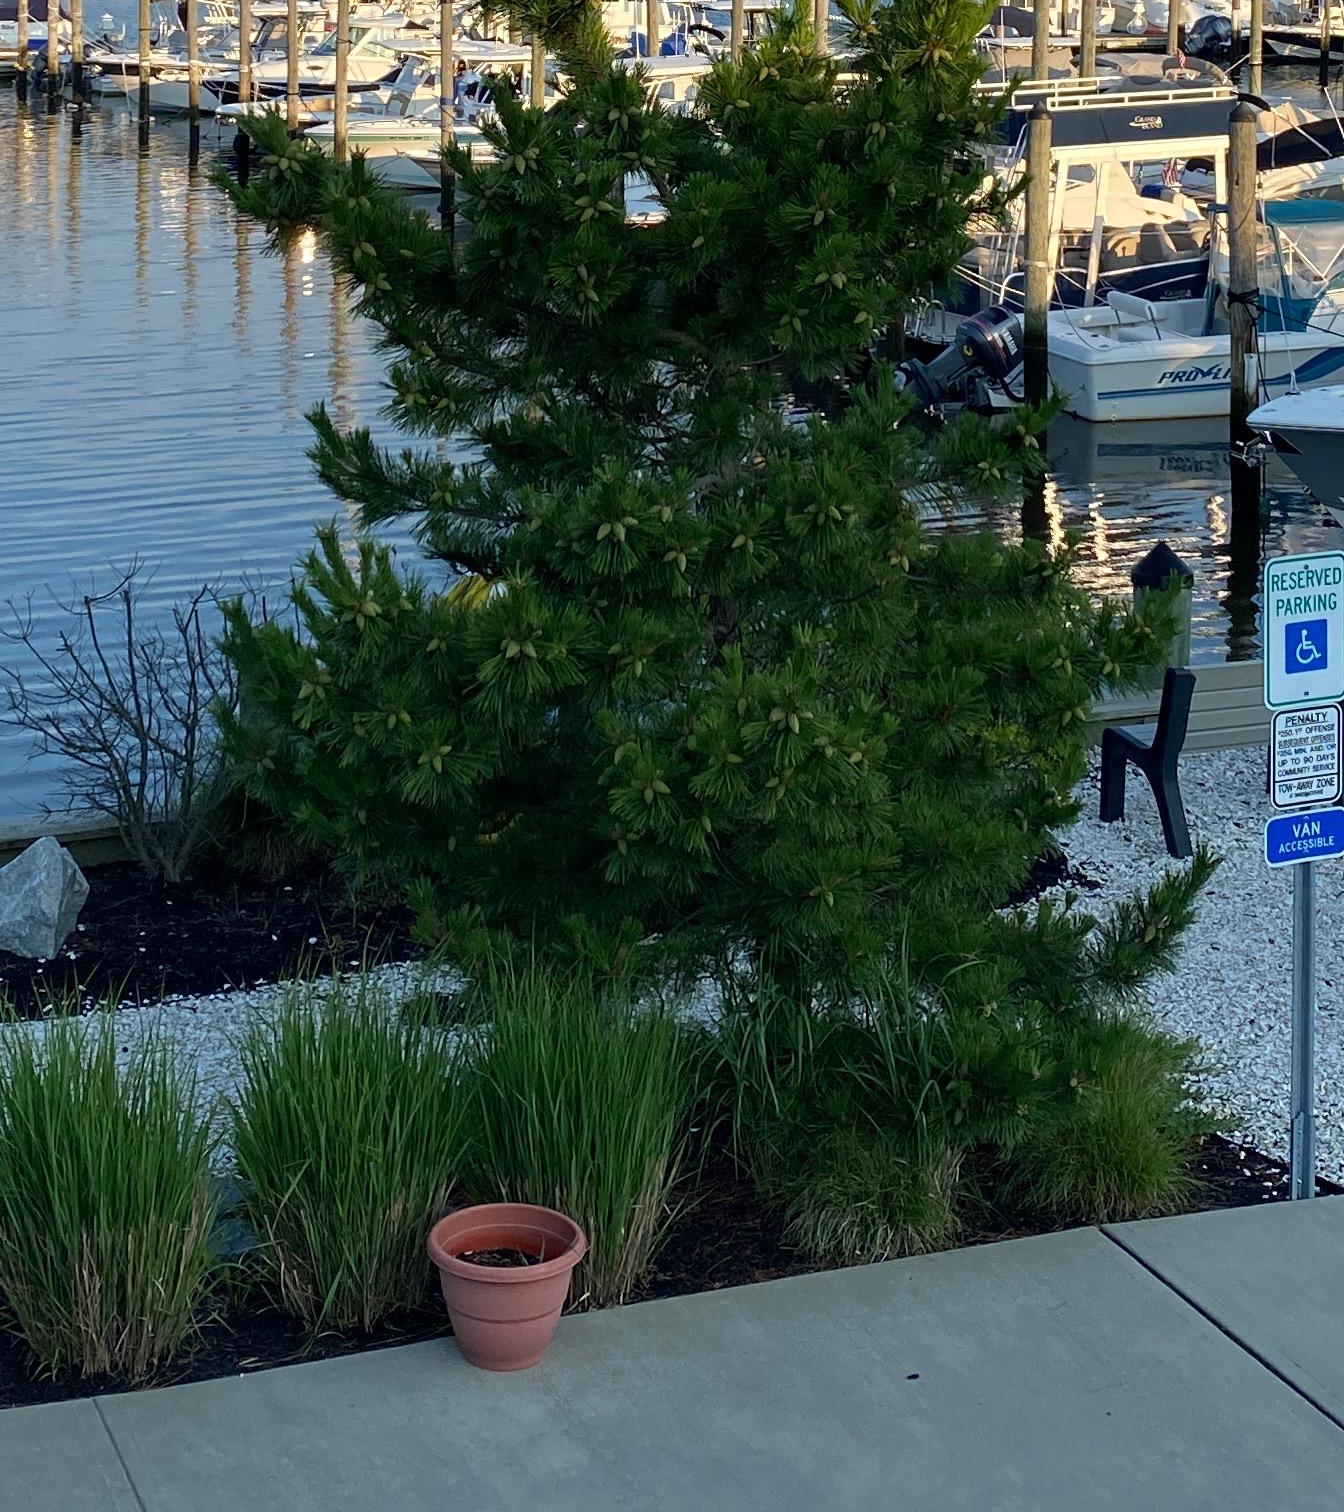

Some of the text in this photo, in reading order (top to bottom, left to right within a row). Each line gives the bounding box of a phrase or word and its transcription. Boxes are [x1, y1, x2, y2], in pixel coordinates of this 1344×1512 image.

[1271, 567, 1342, 592] RESERVED
[1276, 593, 1337, 617] PARKING
[1285, 712, 1328, 727] PENALTY
[1290, 757, 1301, 765] TO
[1316, 753, 1335, 761] DAYS
[1316, 777, 1336, 788] ZONE
[1292, 821, 1321, 838] VAN
[1279, 836, 1335, 853] ACCESSIBLE
